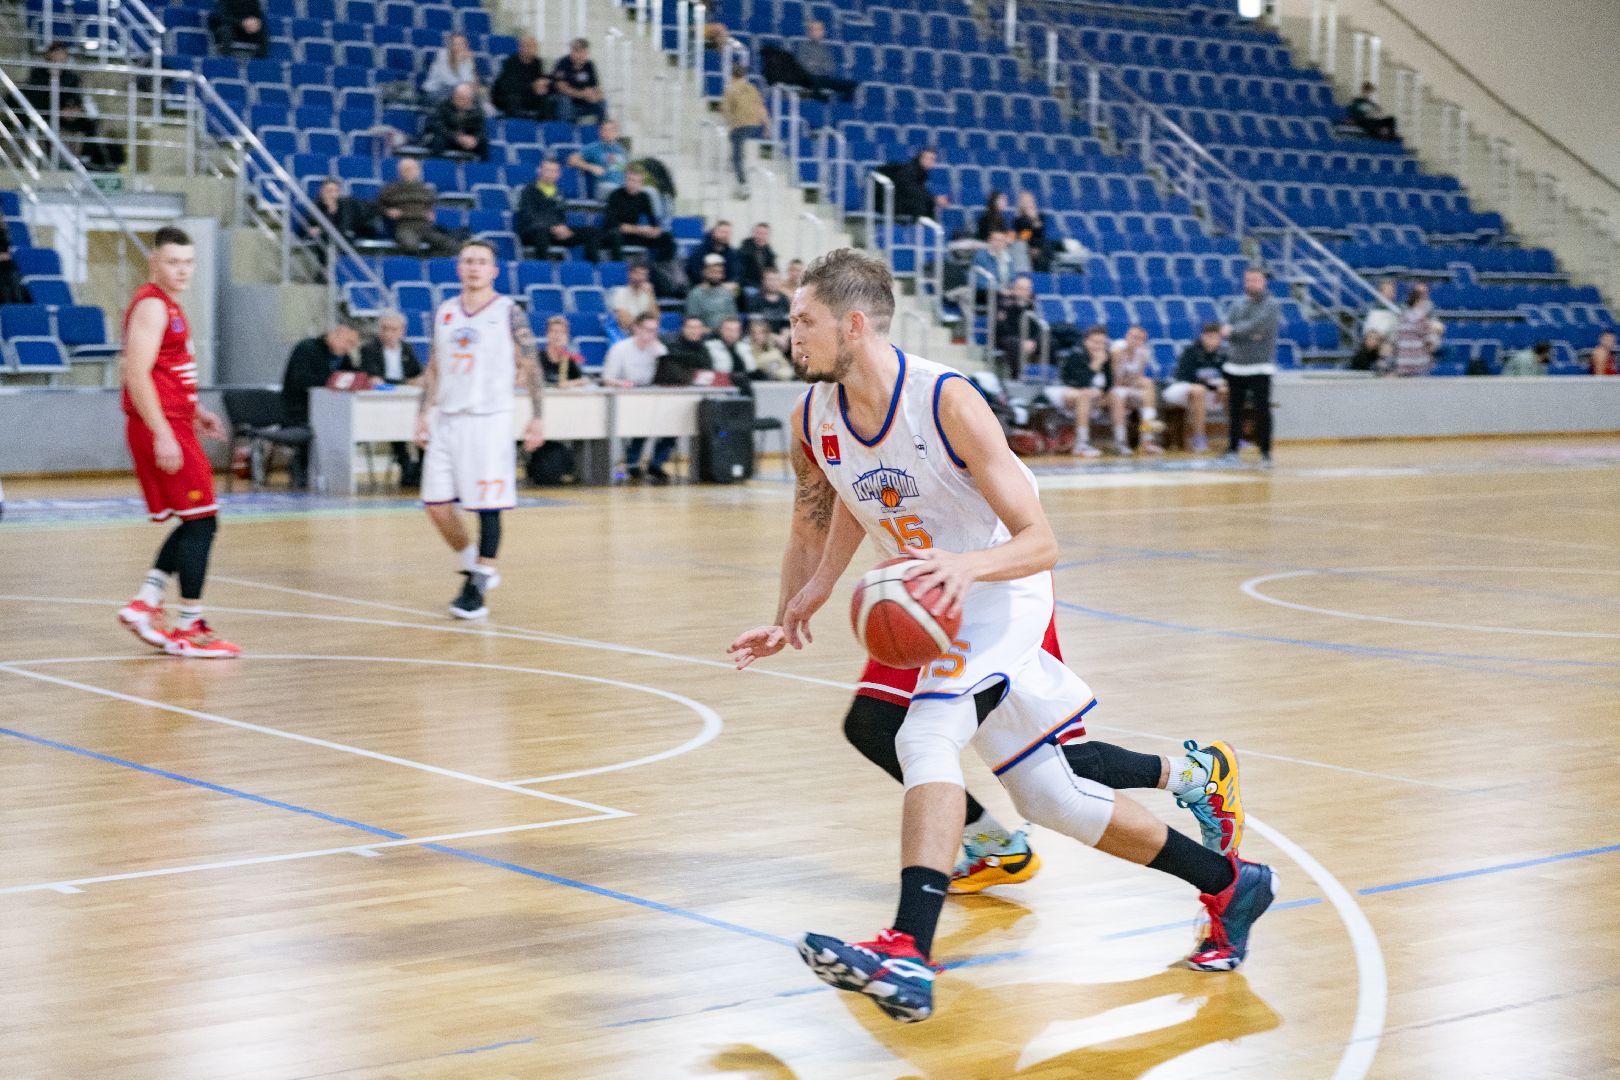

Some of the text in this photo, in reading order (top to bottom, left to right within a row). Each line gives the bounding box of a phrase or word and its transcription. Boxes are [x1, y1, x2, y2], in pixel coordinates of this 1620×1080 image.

[449, 352, 475, 375] 77
[477, 479, 505, 499] 77
[879, 514, 934, 554] 15
